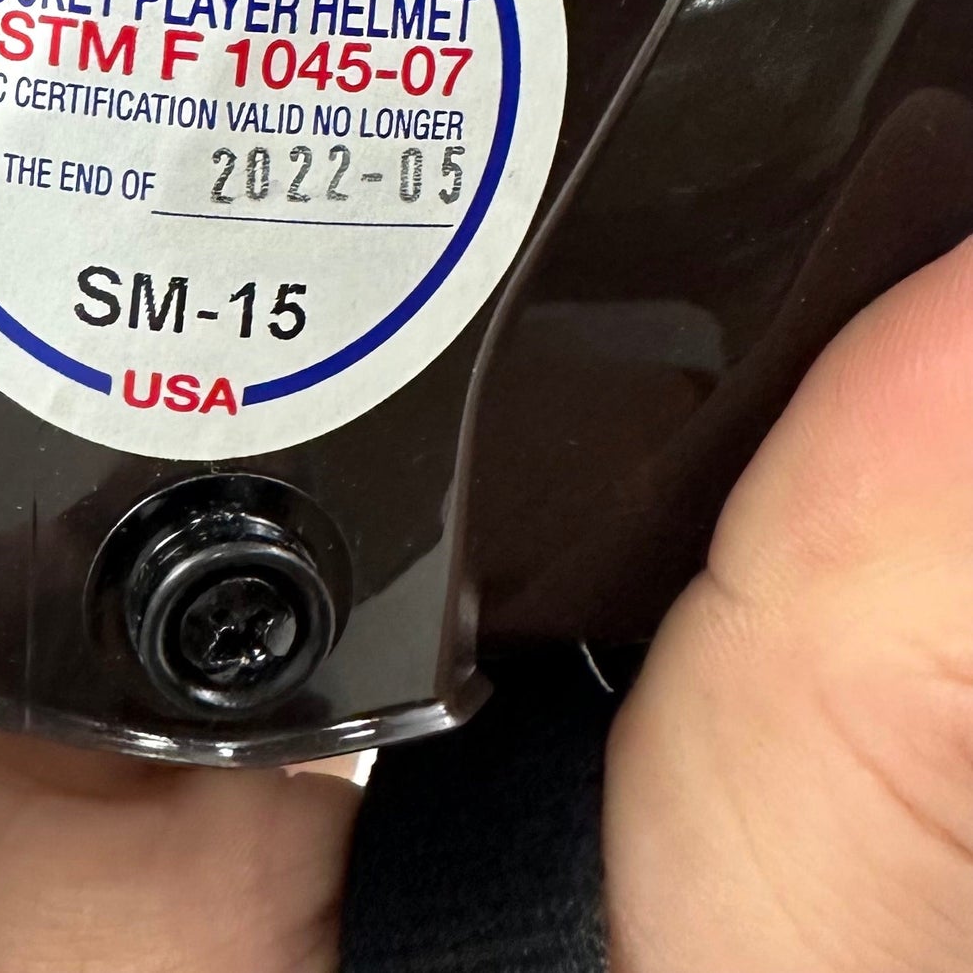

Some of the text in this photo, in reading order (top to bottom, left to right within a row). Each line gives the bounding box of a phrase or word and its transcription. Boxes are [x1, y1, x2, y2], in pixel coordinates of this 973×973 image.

[161, 30, 203, 80] F
[227, 40, 472, 96] 1045-07
[16, 77, 217, 129] CERTIFICATION
[227, 102, 303, 134] VALID
[313, 105, 351, 137] NO
[360, 108, 463, 140] LONGER
[4, 153, 52, 188] THE
[60, 161, 112, 195] END
[122, 170, 156, 200] OF
[211, 145, 467, 206] 2022-05
[74, 266, 306, 340] SM-15
[124, 370, 237, 415] USA
